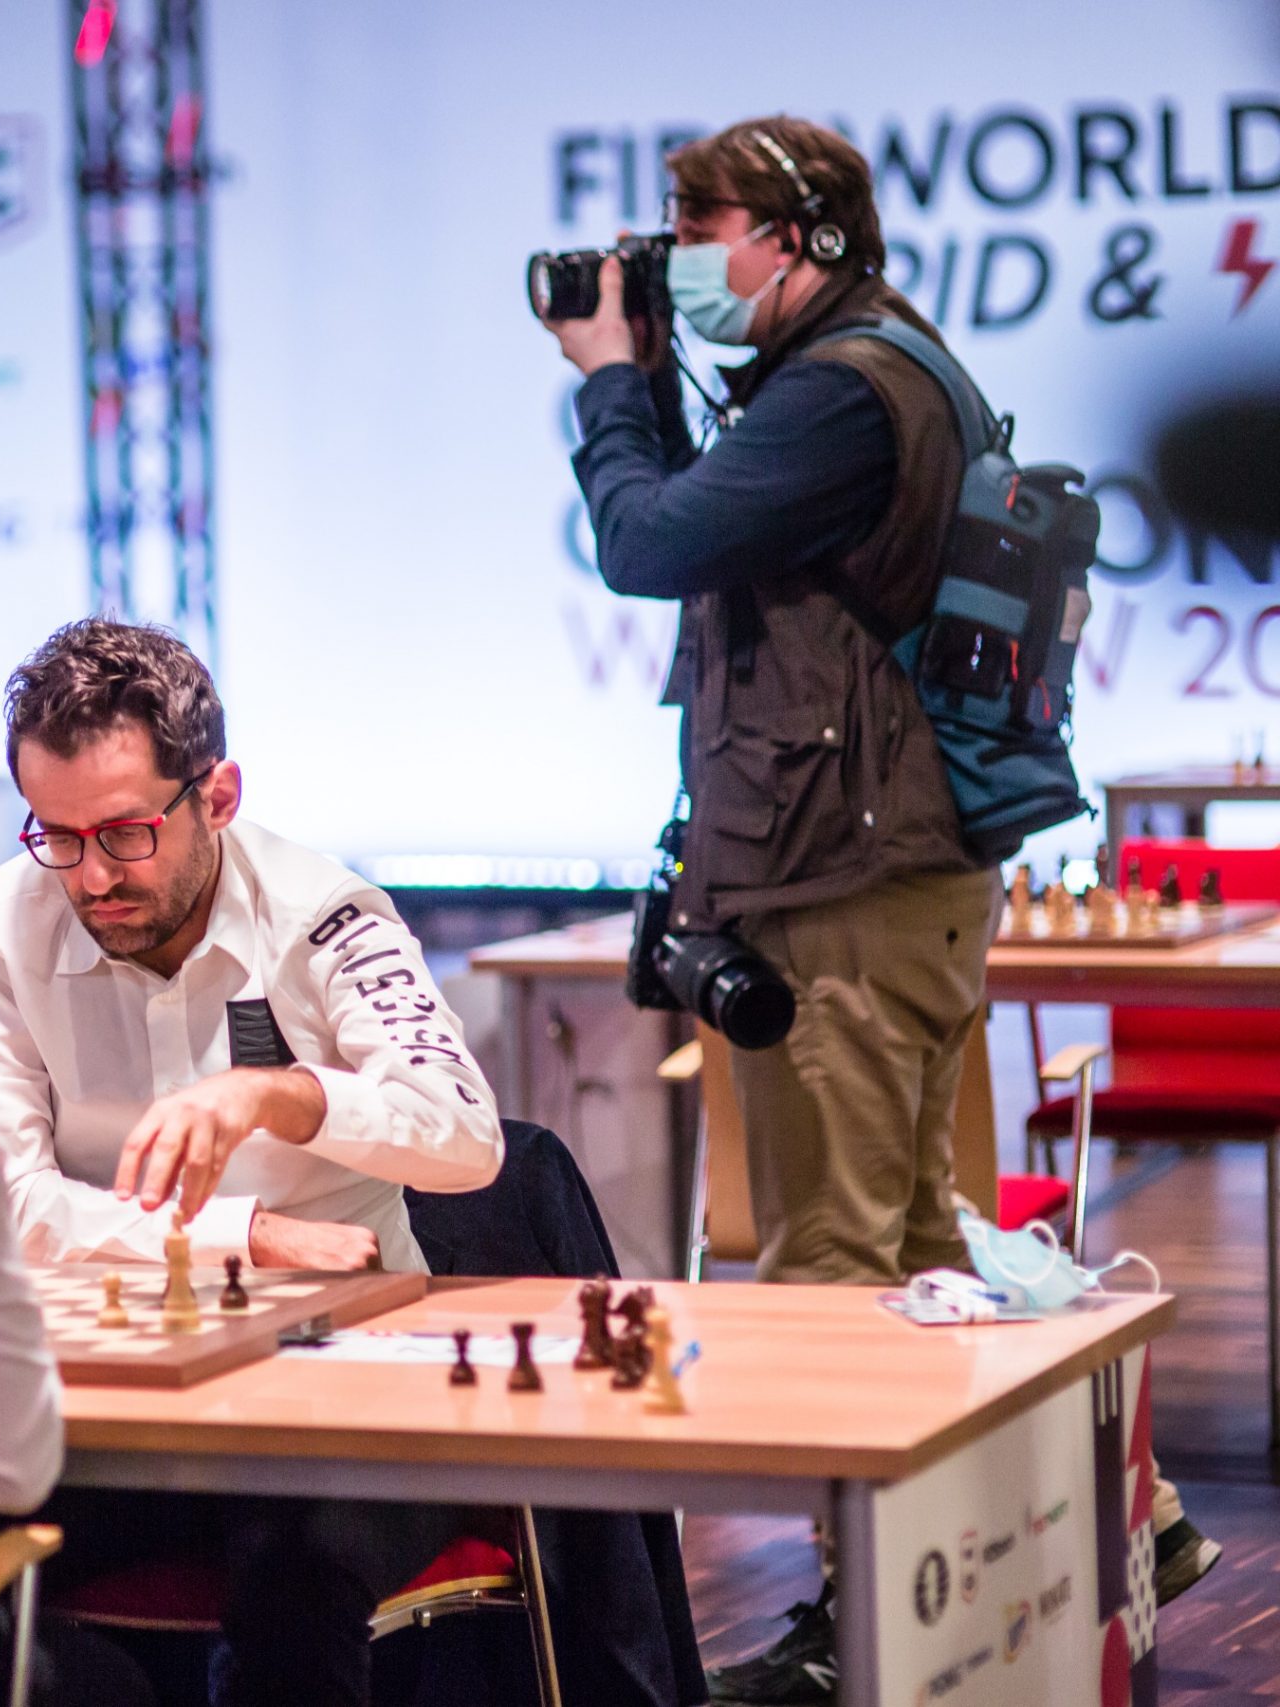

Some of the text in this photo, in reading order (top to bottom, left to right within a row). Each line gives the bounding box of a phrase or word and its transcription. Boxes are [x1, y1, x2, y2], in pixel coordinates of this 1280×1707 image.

[832, 98, 1280, 212] WORLD
[874, 222, 1162, 330] PID &
